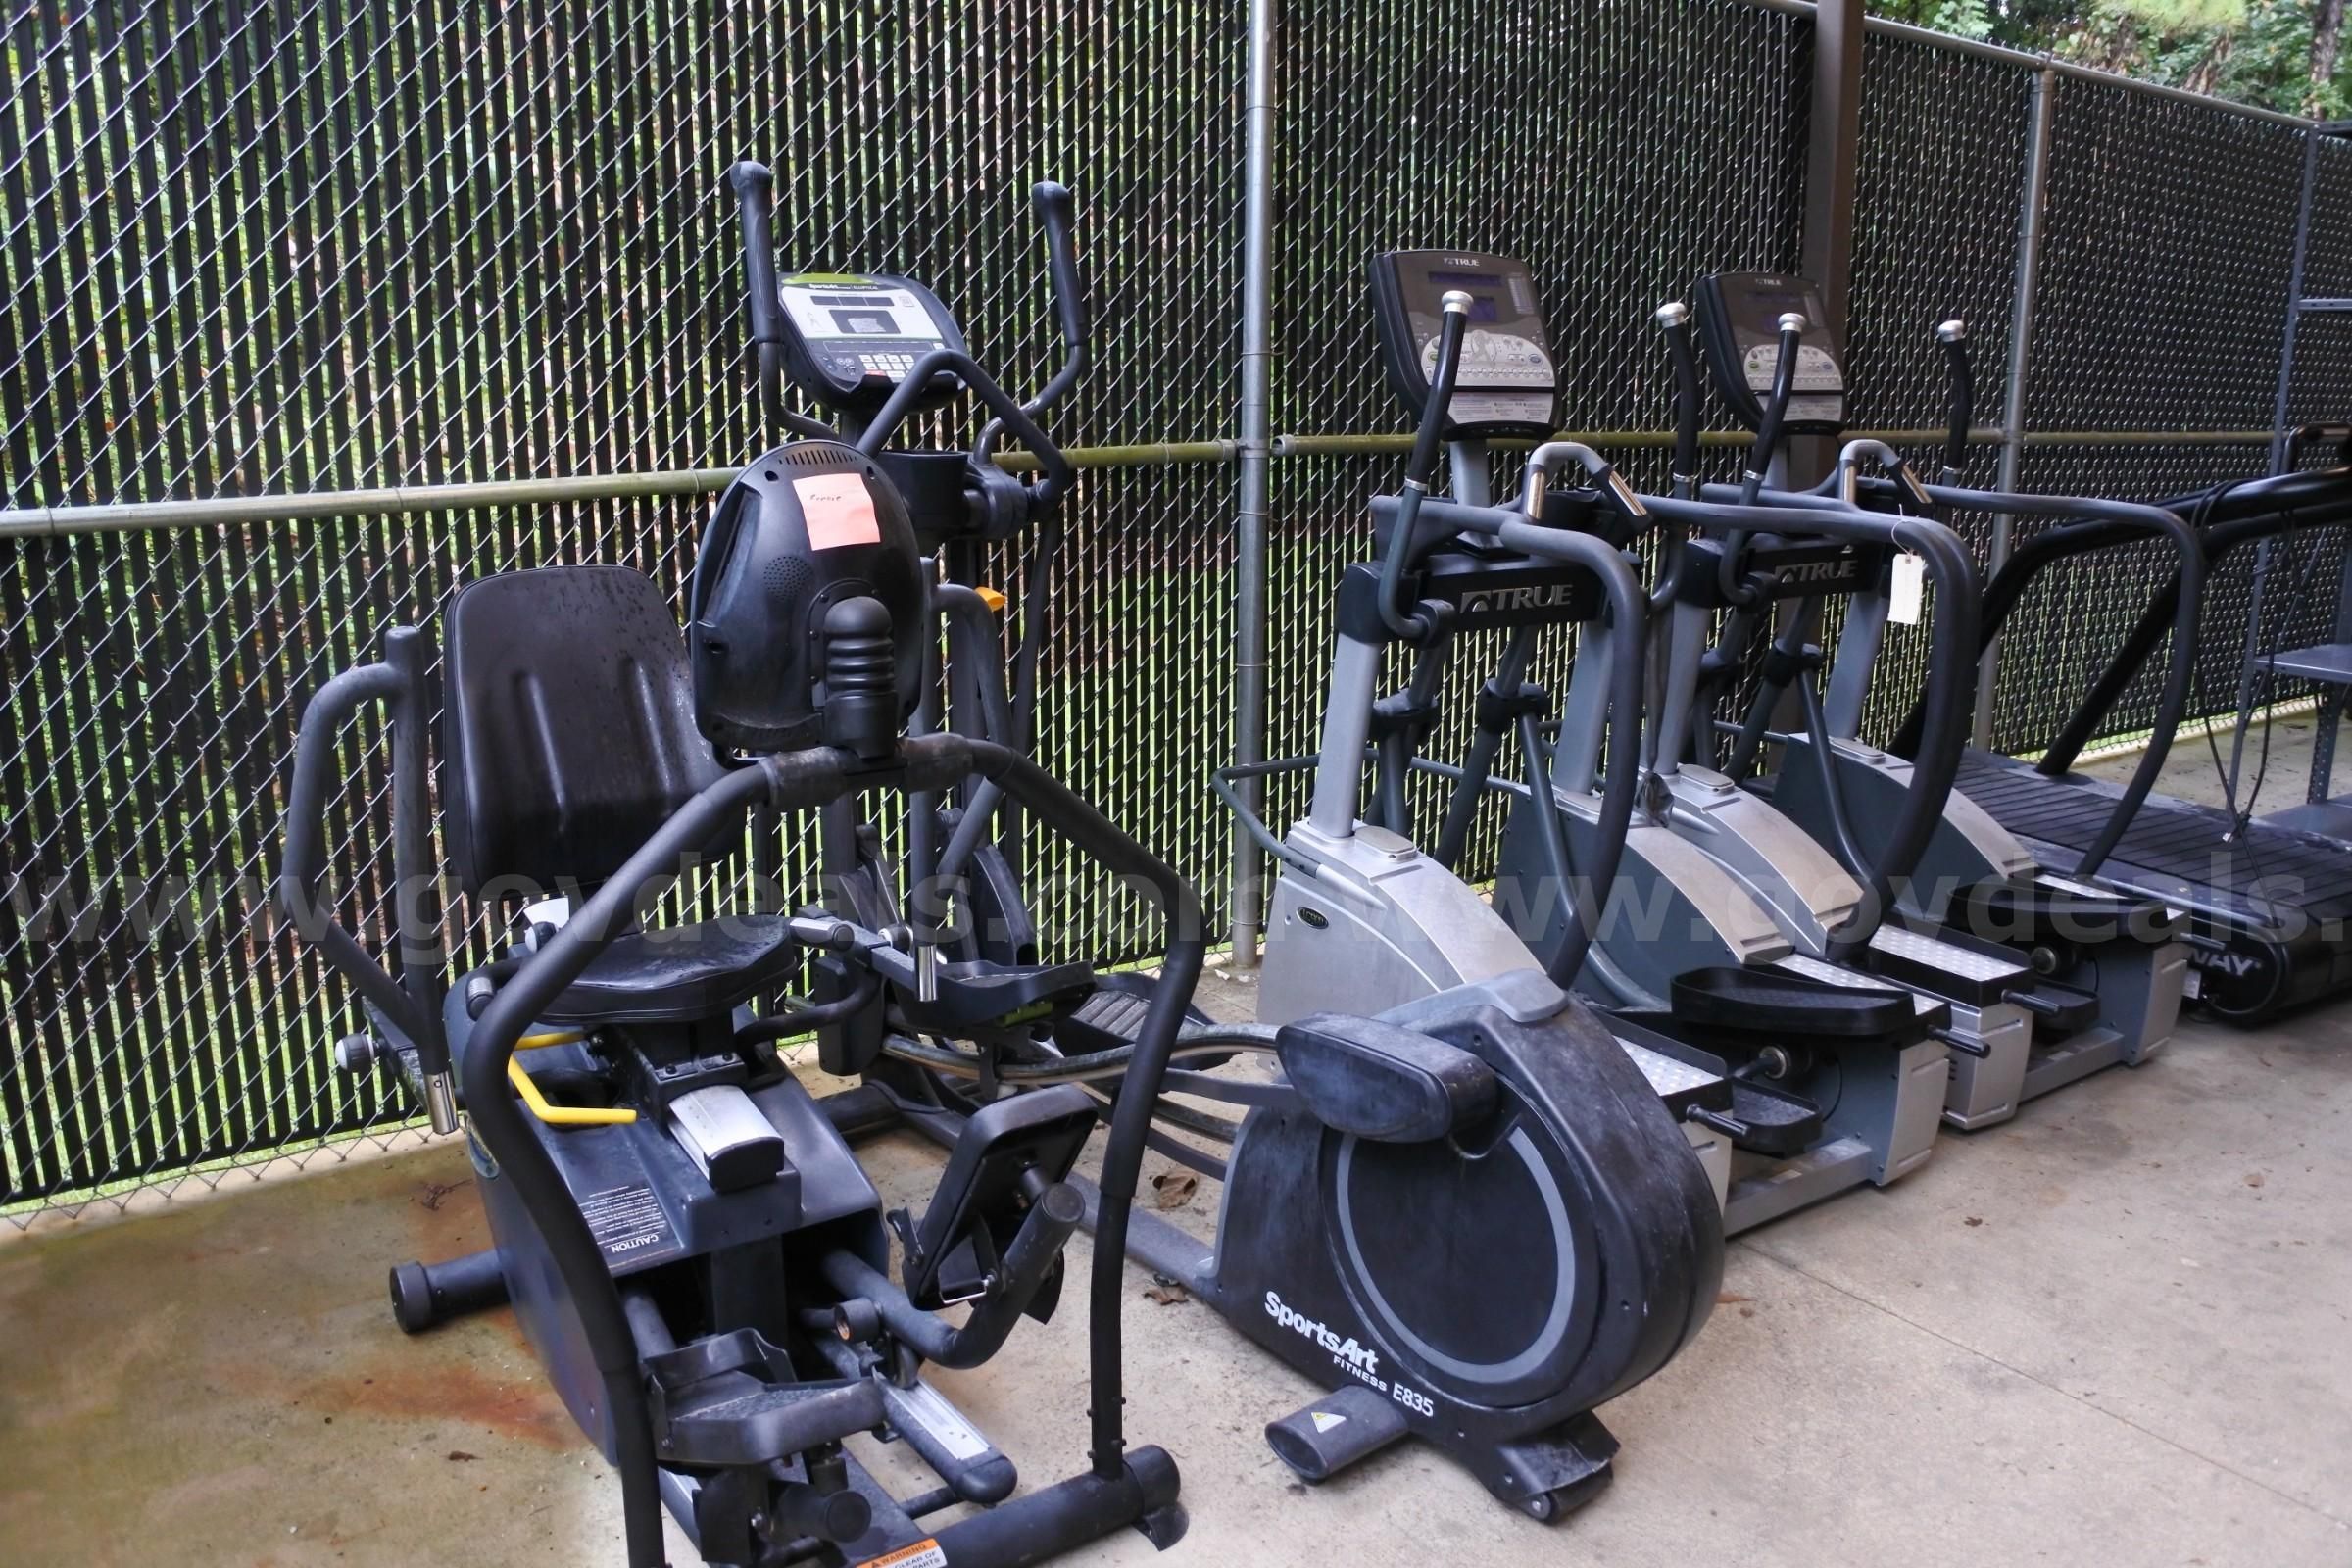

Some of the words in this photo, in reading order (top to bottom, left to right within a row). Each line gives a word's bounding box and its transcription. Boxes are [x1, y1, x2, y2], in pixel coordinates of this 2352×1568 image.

[1454, 257, 1480, 267] TRUE
[1800, 560, 1858, 581] TRUE
[1491, 585, 1573, 610] TRUE
[611, 1234, 660, 1253] CAUTION
[1264, 1290, 1379, 1374] SportsArt
[1333, 1354, 1388, 1392] FITNESS
[1393, 1382, 1434, 1417] E835
[882, 1544, 926, 1564] WARNING
